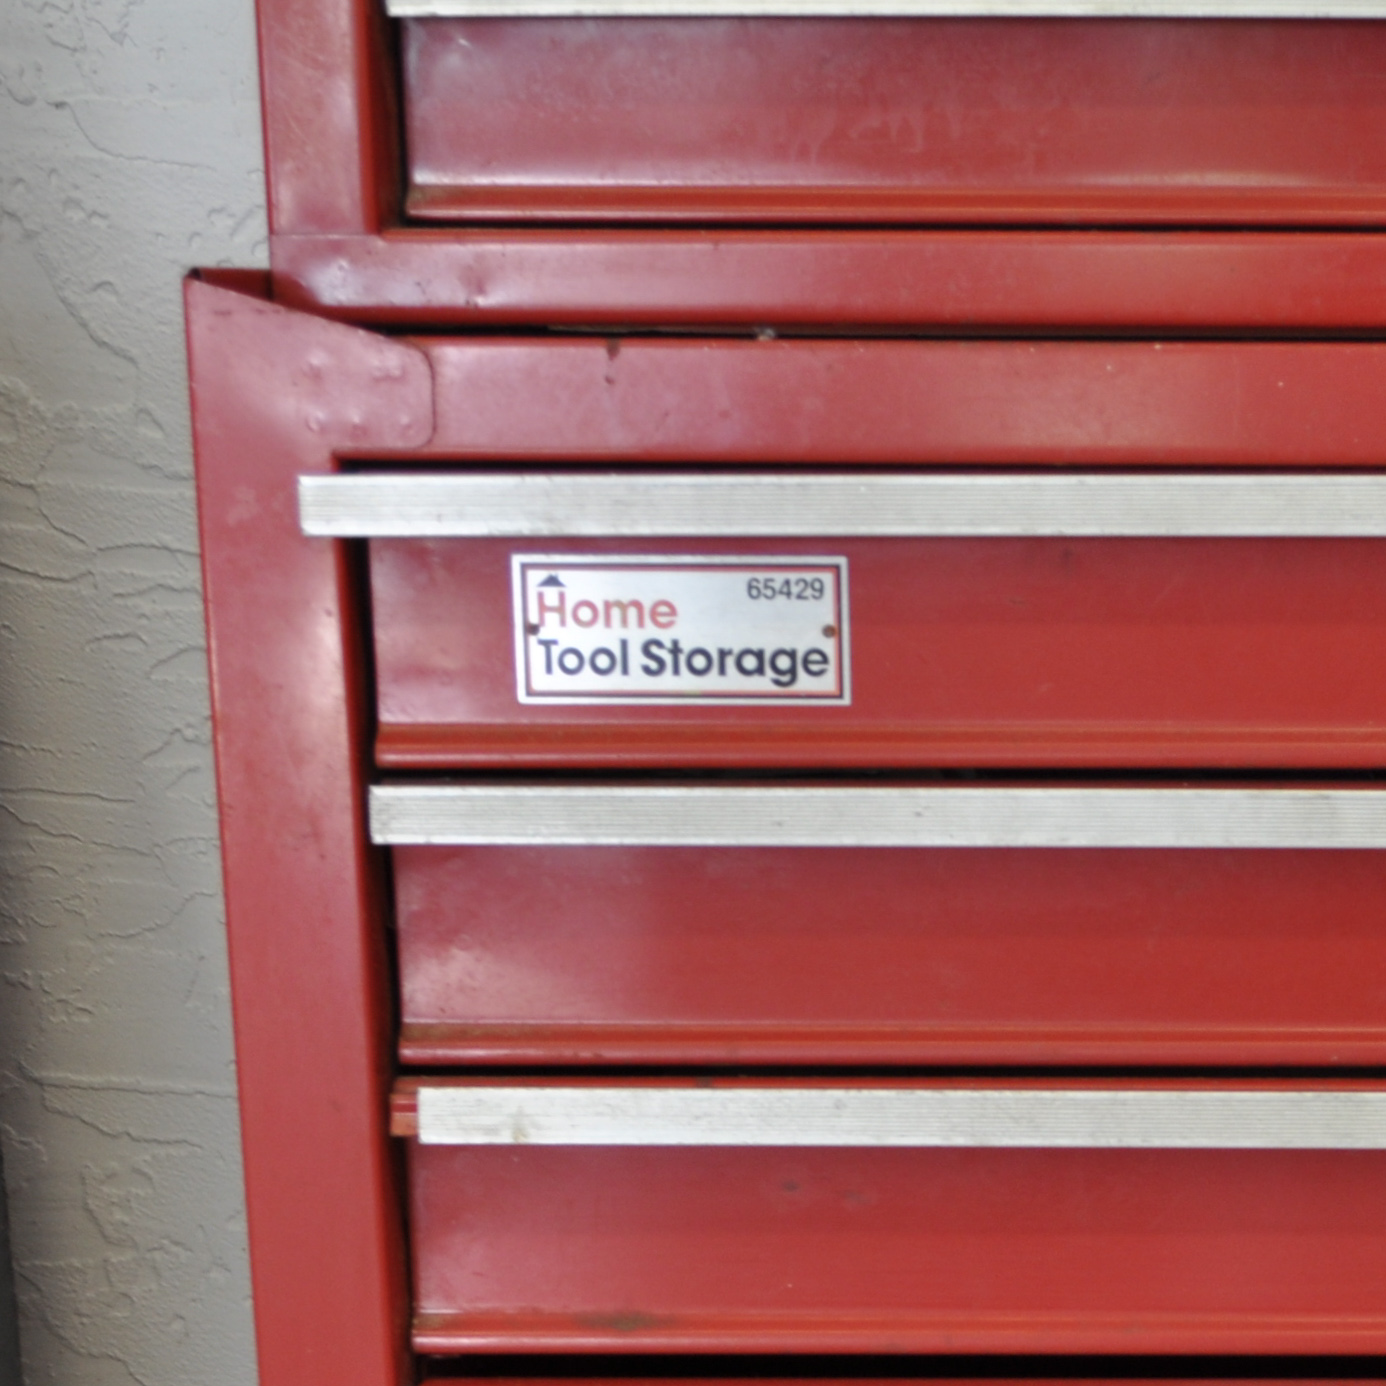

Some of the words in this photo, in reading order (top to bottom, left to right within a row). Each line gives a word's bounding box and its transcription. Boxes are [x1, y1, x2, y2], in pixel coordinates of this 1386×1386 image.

[746, 577, 825, 600] 65429
[537, 590, 678, 629] Home
[537, 638, 629, 677] Tool
[641, 638, 829, 688] Storage
